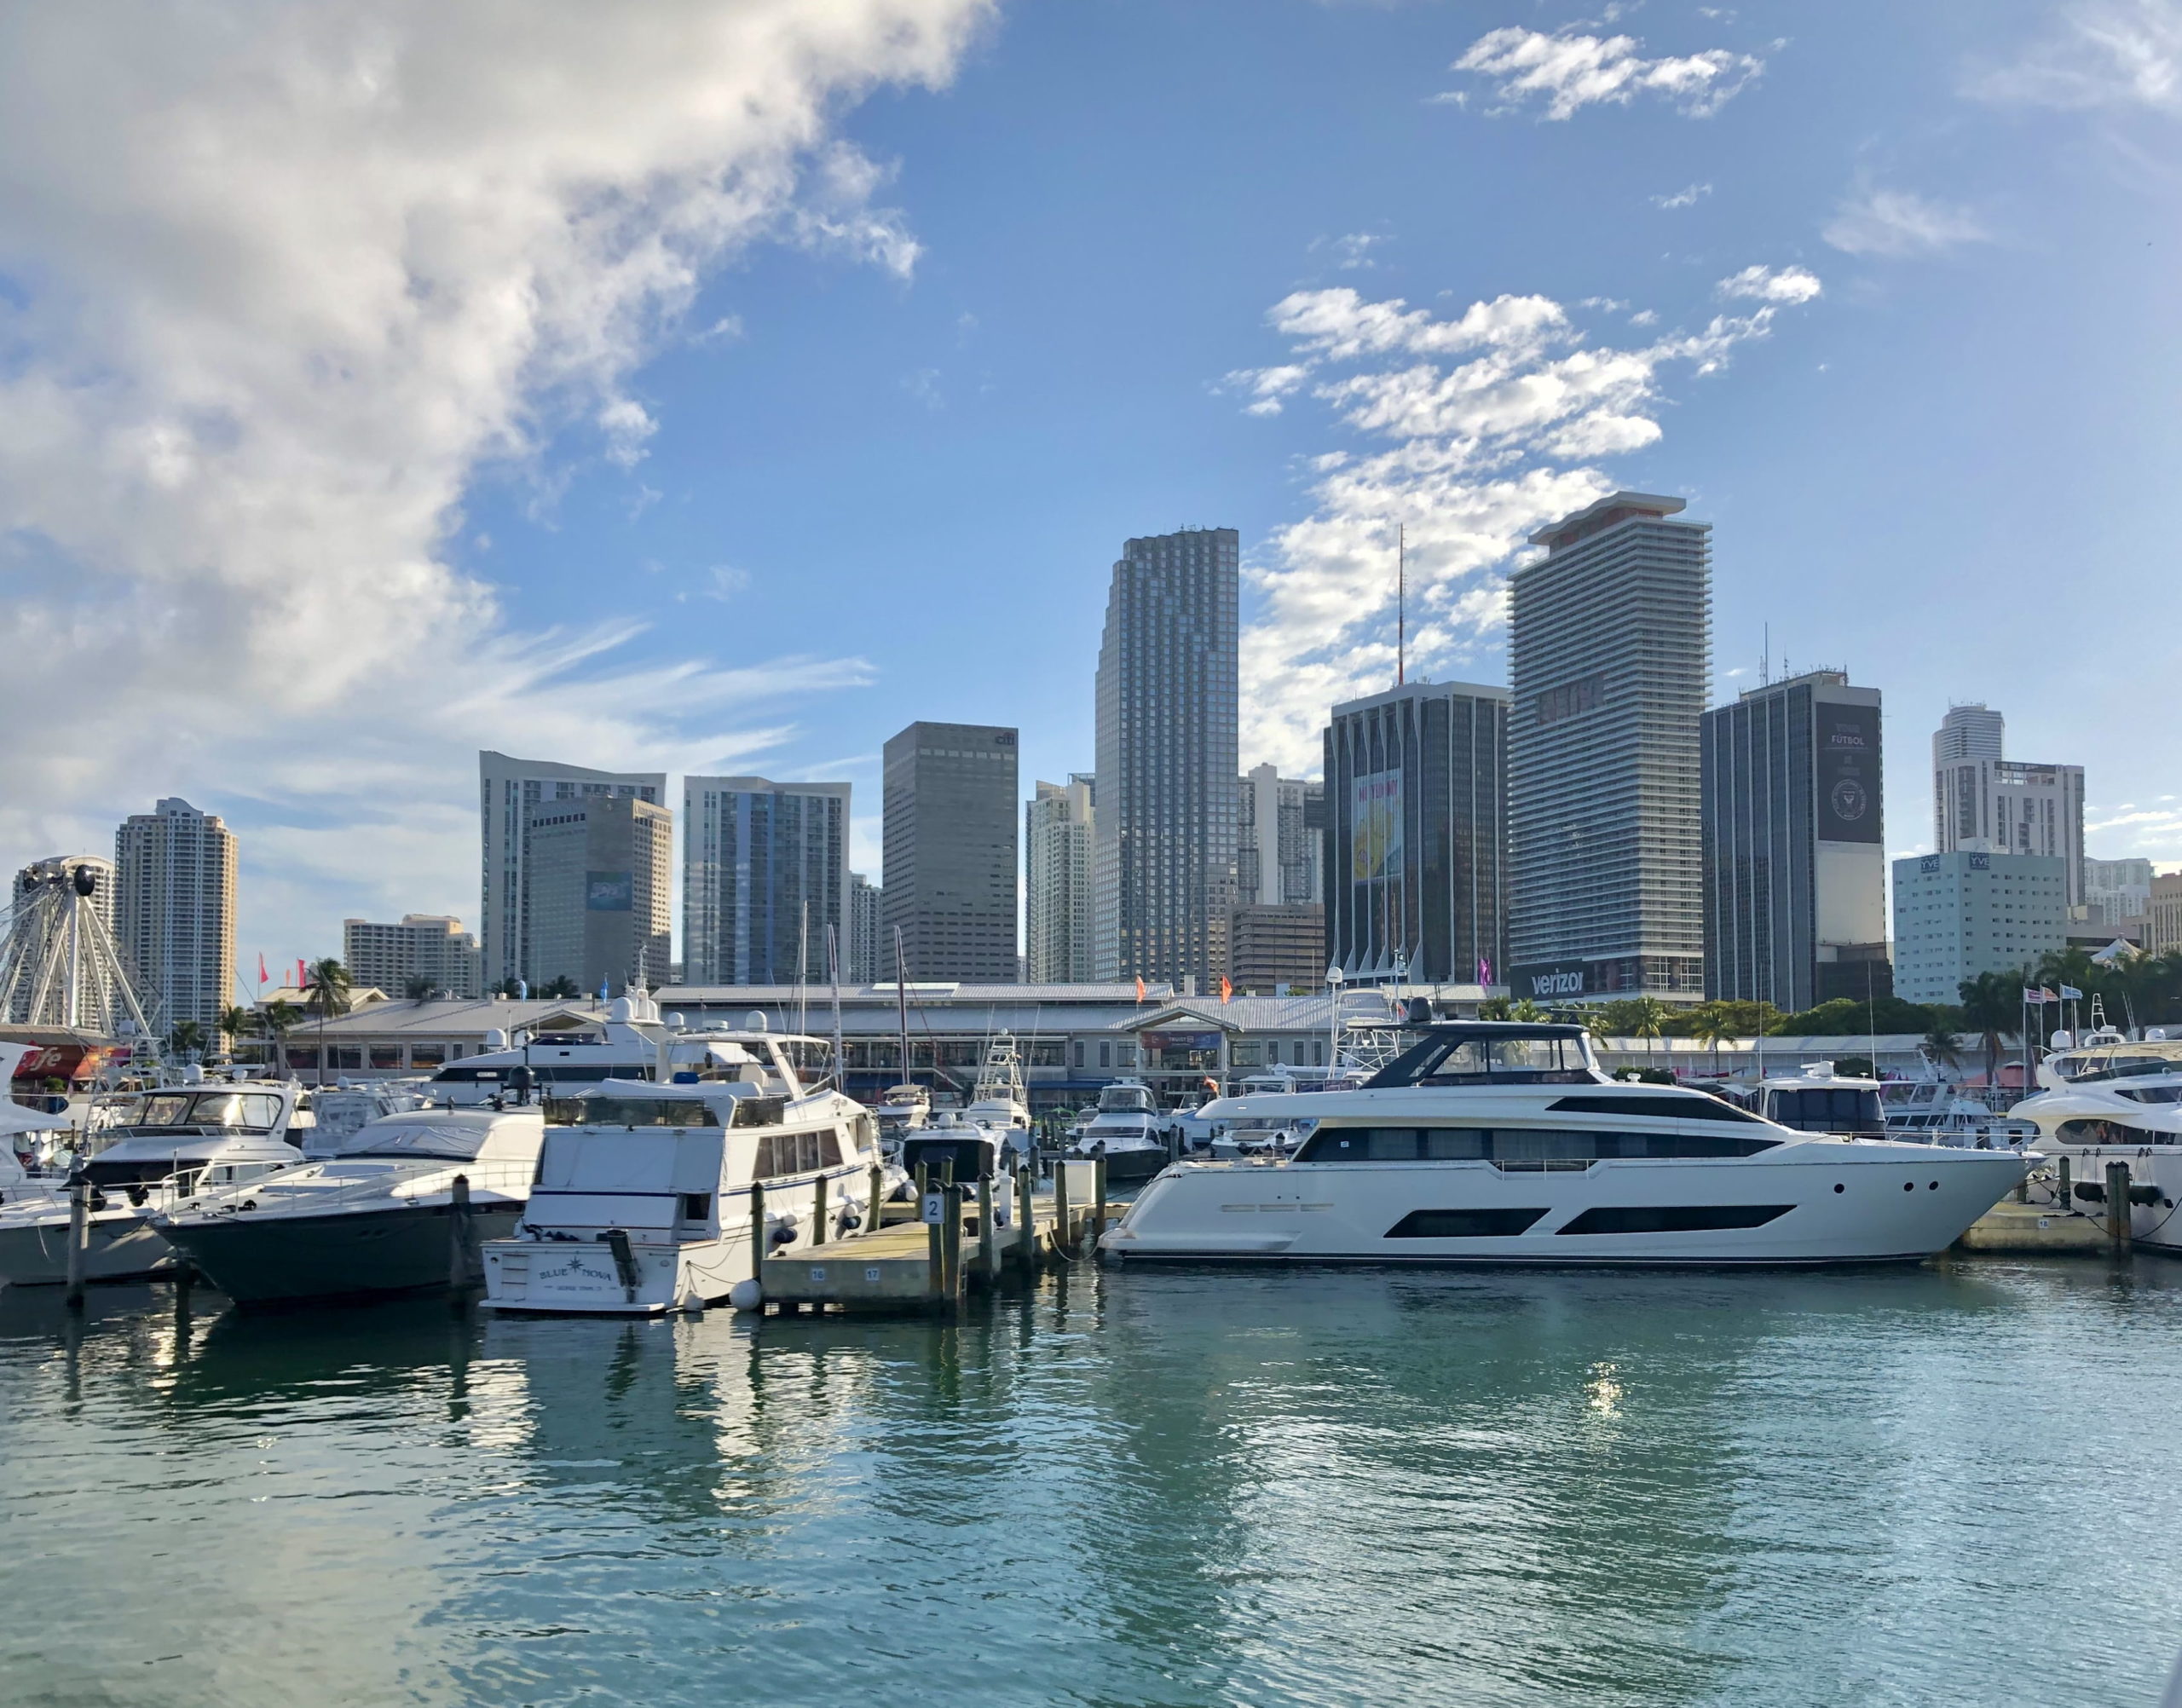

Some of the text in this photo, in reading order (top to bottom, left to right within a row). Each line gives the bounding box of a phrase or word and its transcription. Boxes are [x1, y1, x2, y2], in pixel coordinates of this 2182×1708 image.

[1921, 859, 1939, 869] YVE
[1971, 857, 1990, 867] YVE
[928, 1200, 938, 1216] 2
[539, 1268, 612, 1282] BLUE NOVA
[811, 1270, 824, 1279] 16
[867, 1269, 879, 1279] 17
